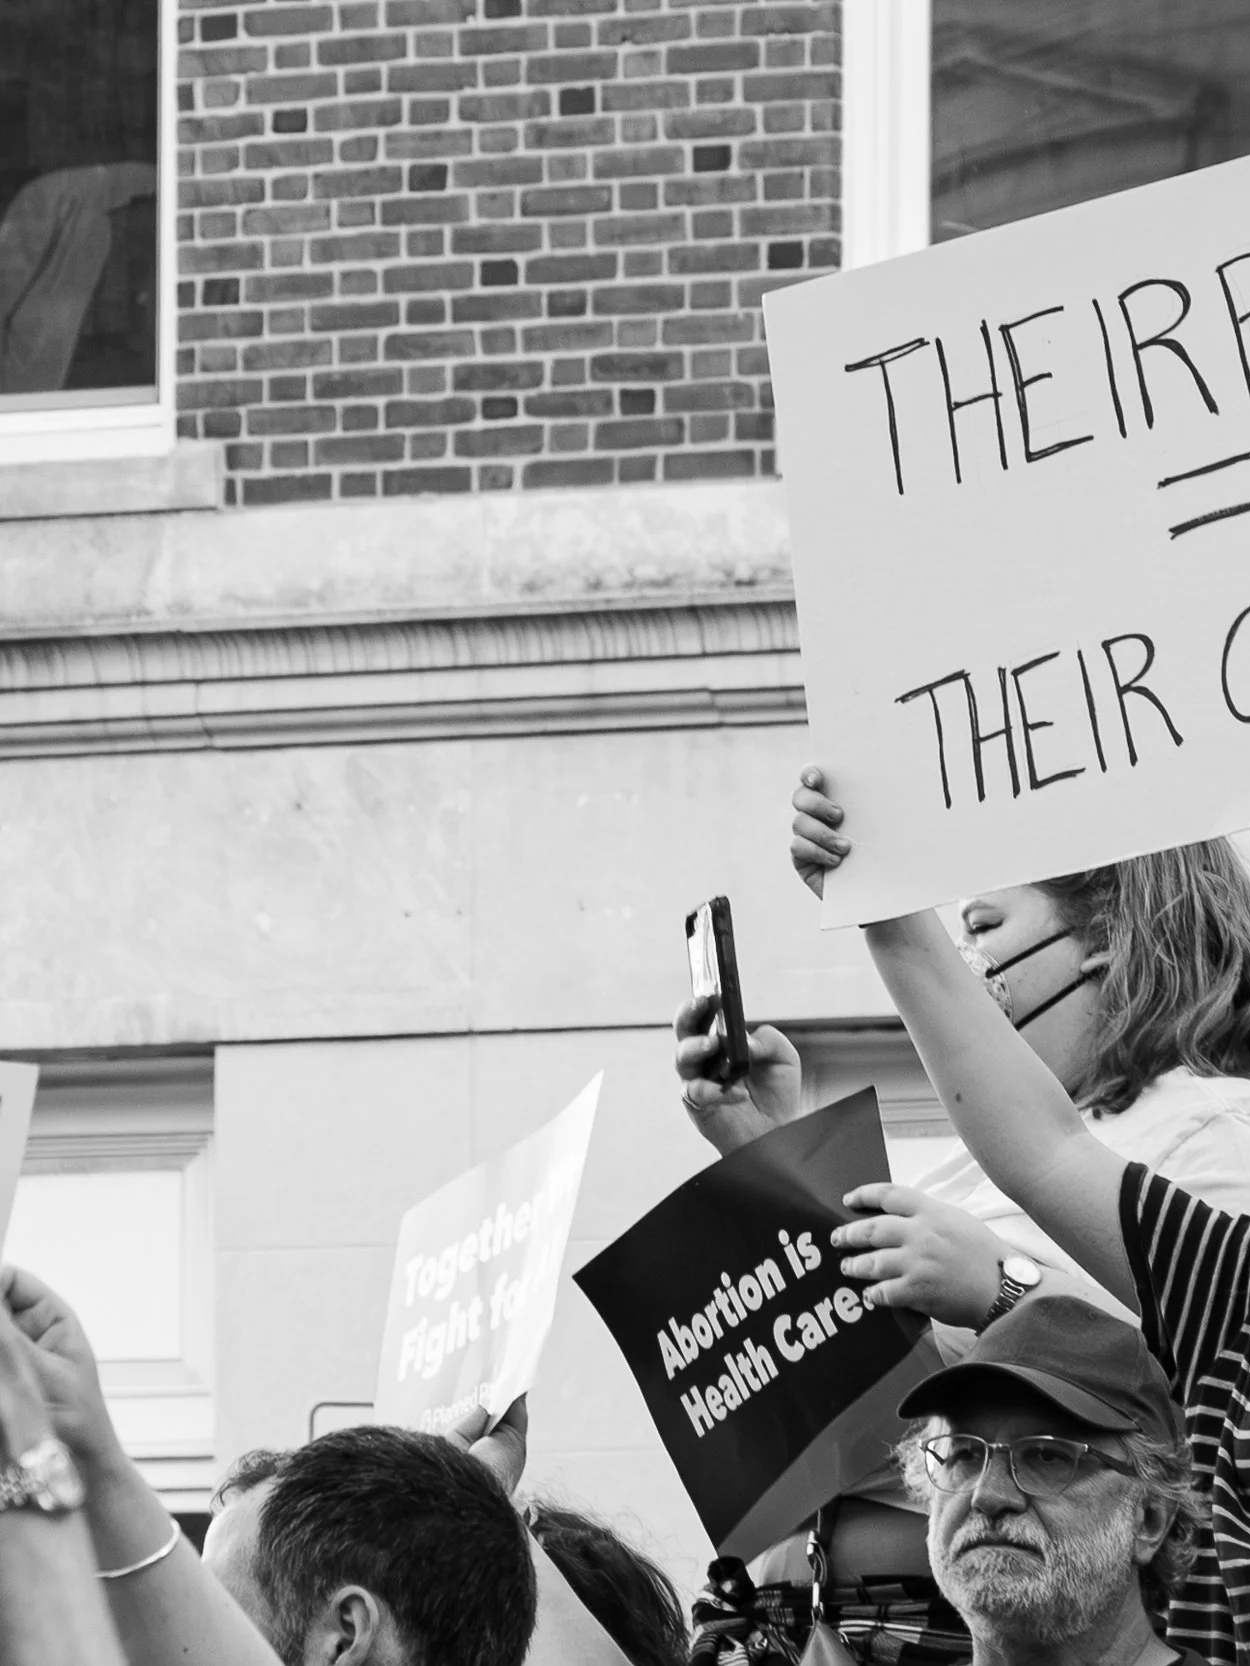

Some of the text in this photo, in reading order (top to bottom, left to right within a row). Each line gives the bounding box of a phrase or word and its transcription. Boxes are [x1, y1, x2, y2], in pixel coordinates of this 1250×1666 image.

[845, 277, 1219, 495] THEIR
[894, 632, 1184, 809] THEIR
[397, 1294, 485, 1383] Fight
[656, 1257, 787, 1381] Abortion
[777, 1228, 822, 1280] is
[679, 1337, 780, 1439] Health
